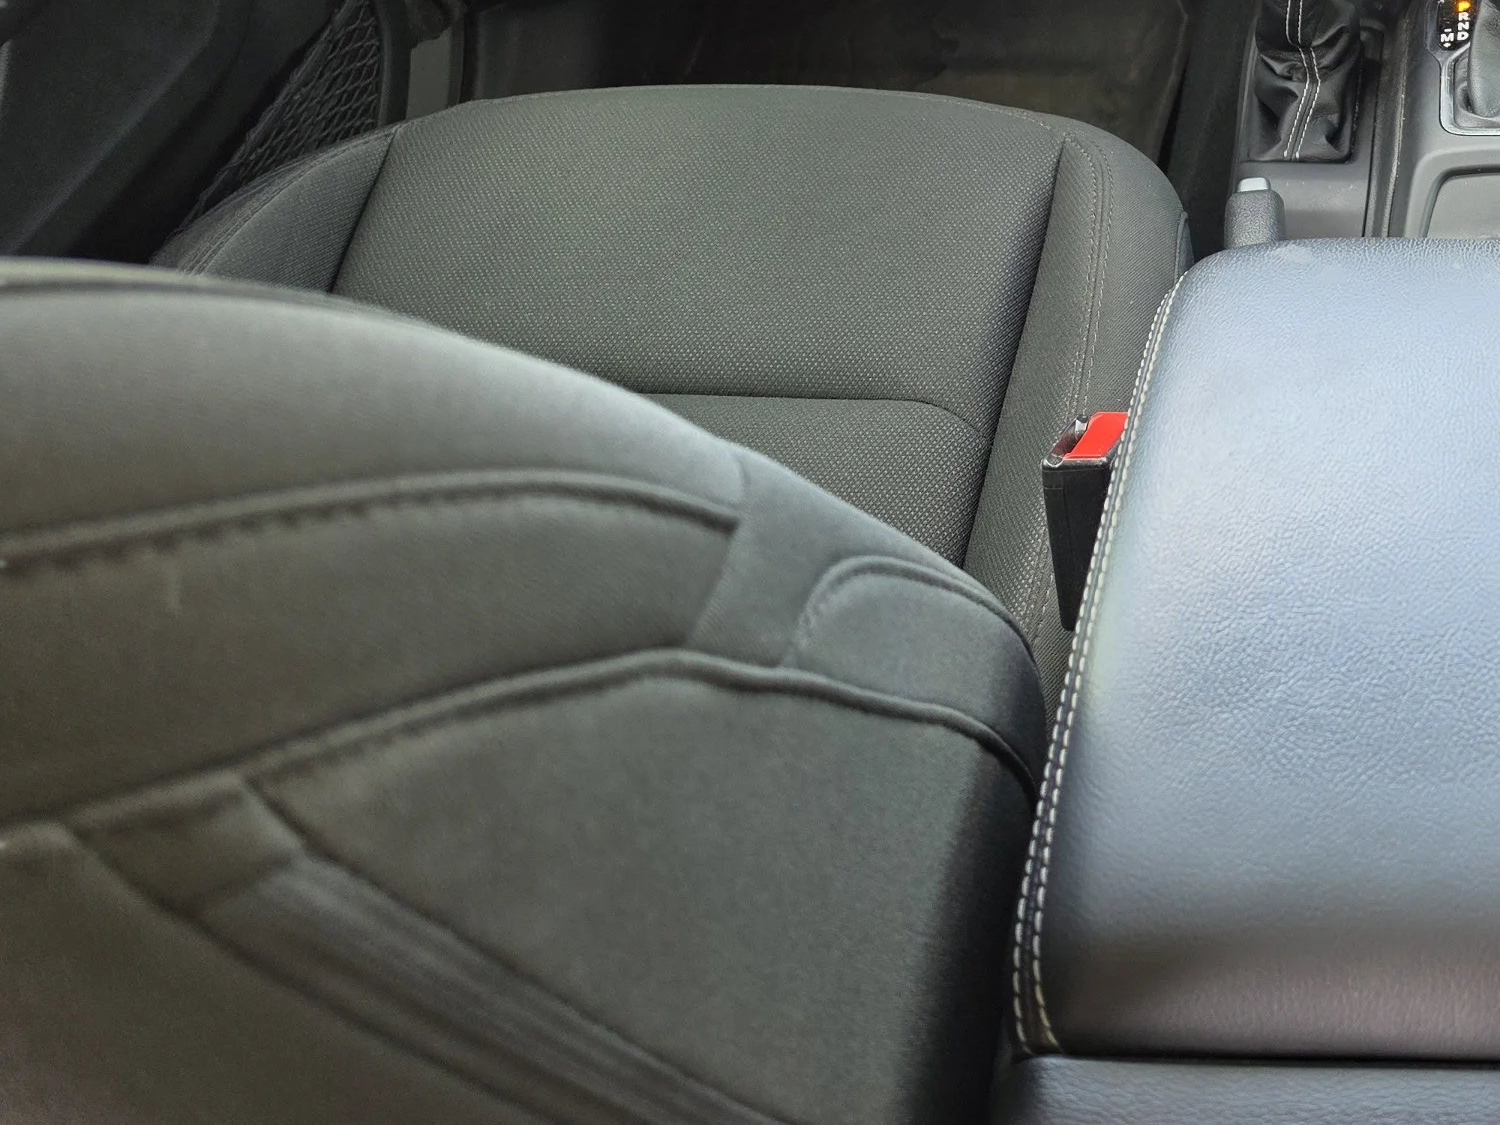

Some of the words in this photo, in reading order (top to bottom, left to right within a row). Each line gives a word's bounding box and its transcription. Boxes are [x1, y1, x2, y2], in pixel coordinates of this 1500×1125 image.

[1459, 12, 1470, 21] R
[1458, 22, 1469, 30] N
[1441, 33, 1454, 42] M
[1457, 32, 1469, 40] D
